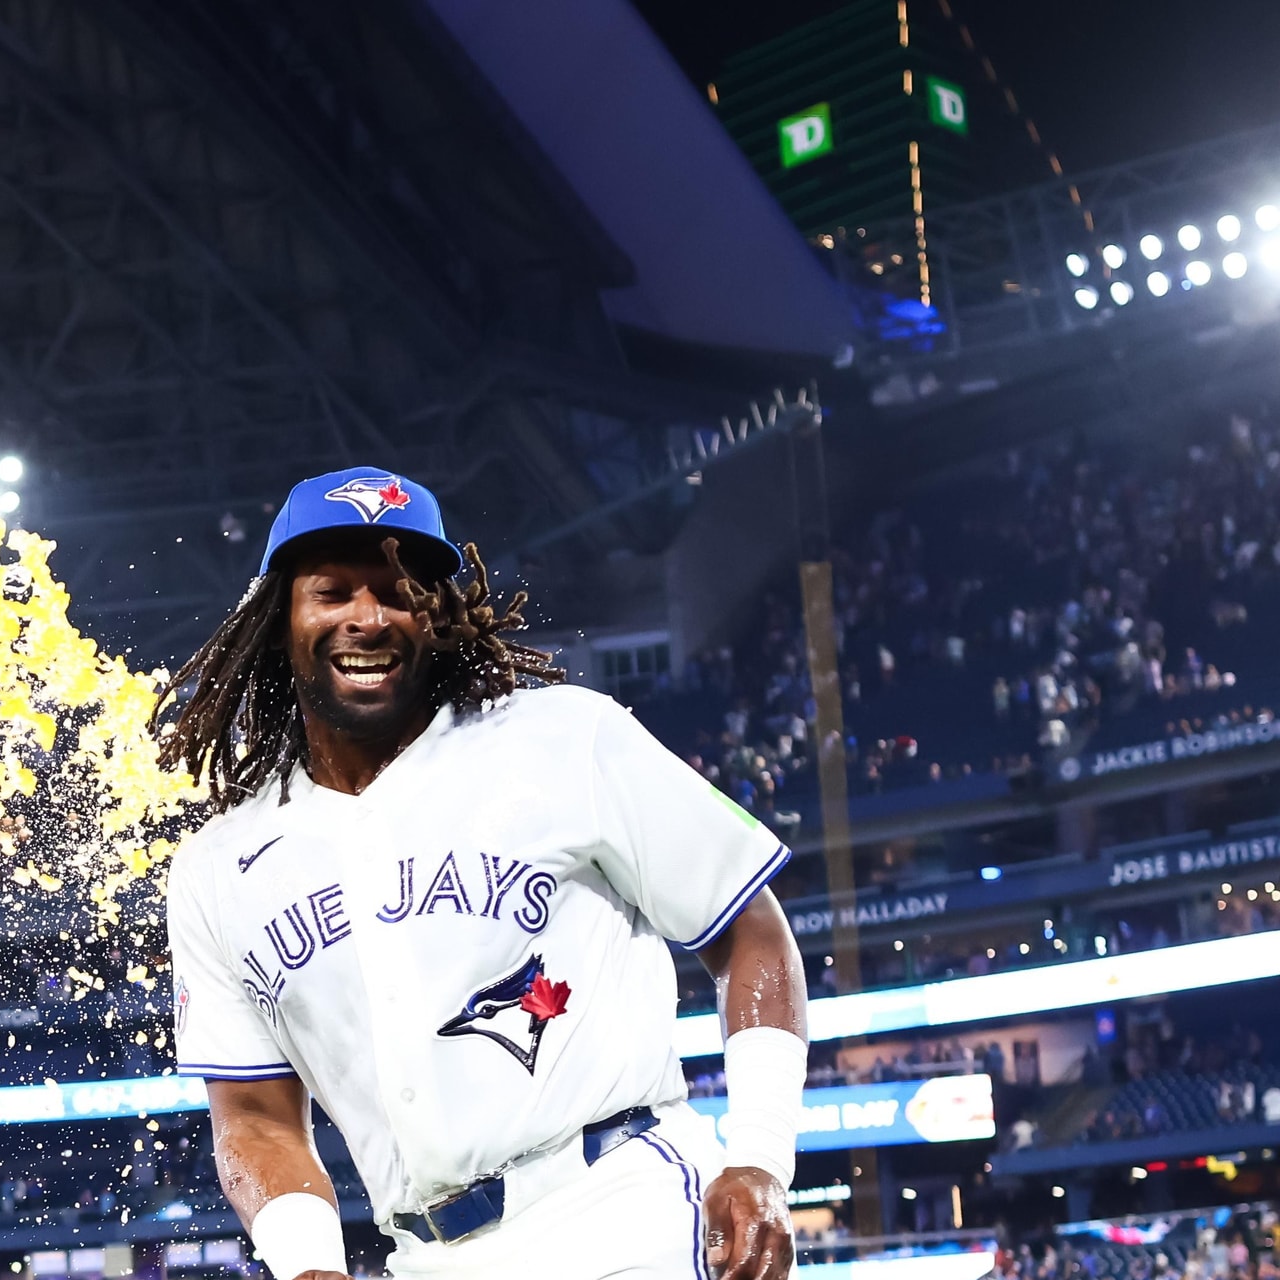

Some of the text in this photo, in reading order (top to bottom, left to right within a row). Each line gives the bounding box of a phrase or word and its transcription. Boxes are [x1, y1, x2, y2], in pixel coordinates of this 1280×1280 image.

[783, 116, 825, 157] TD
[1092, 719, 1280, 775] JACKIE ROBINSO
[1109, 834, 1280, 886] JOSE BAUTIST
[376, 850, 558, 934] JAYS
[792, 892, 948, 934] ROY HALLADAY
